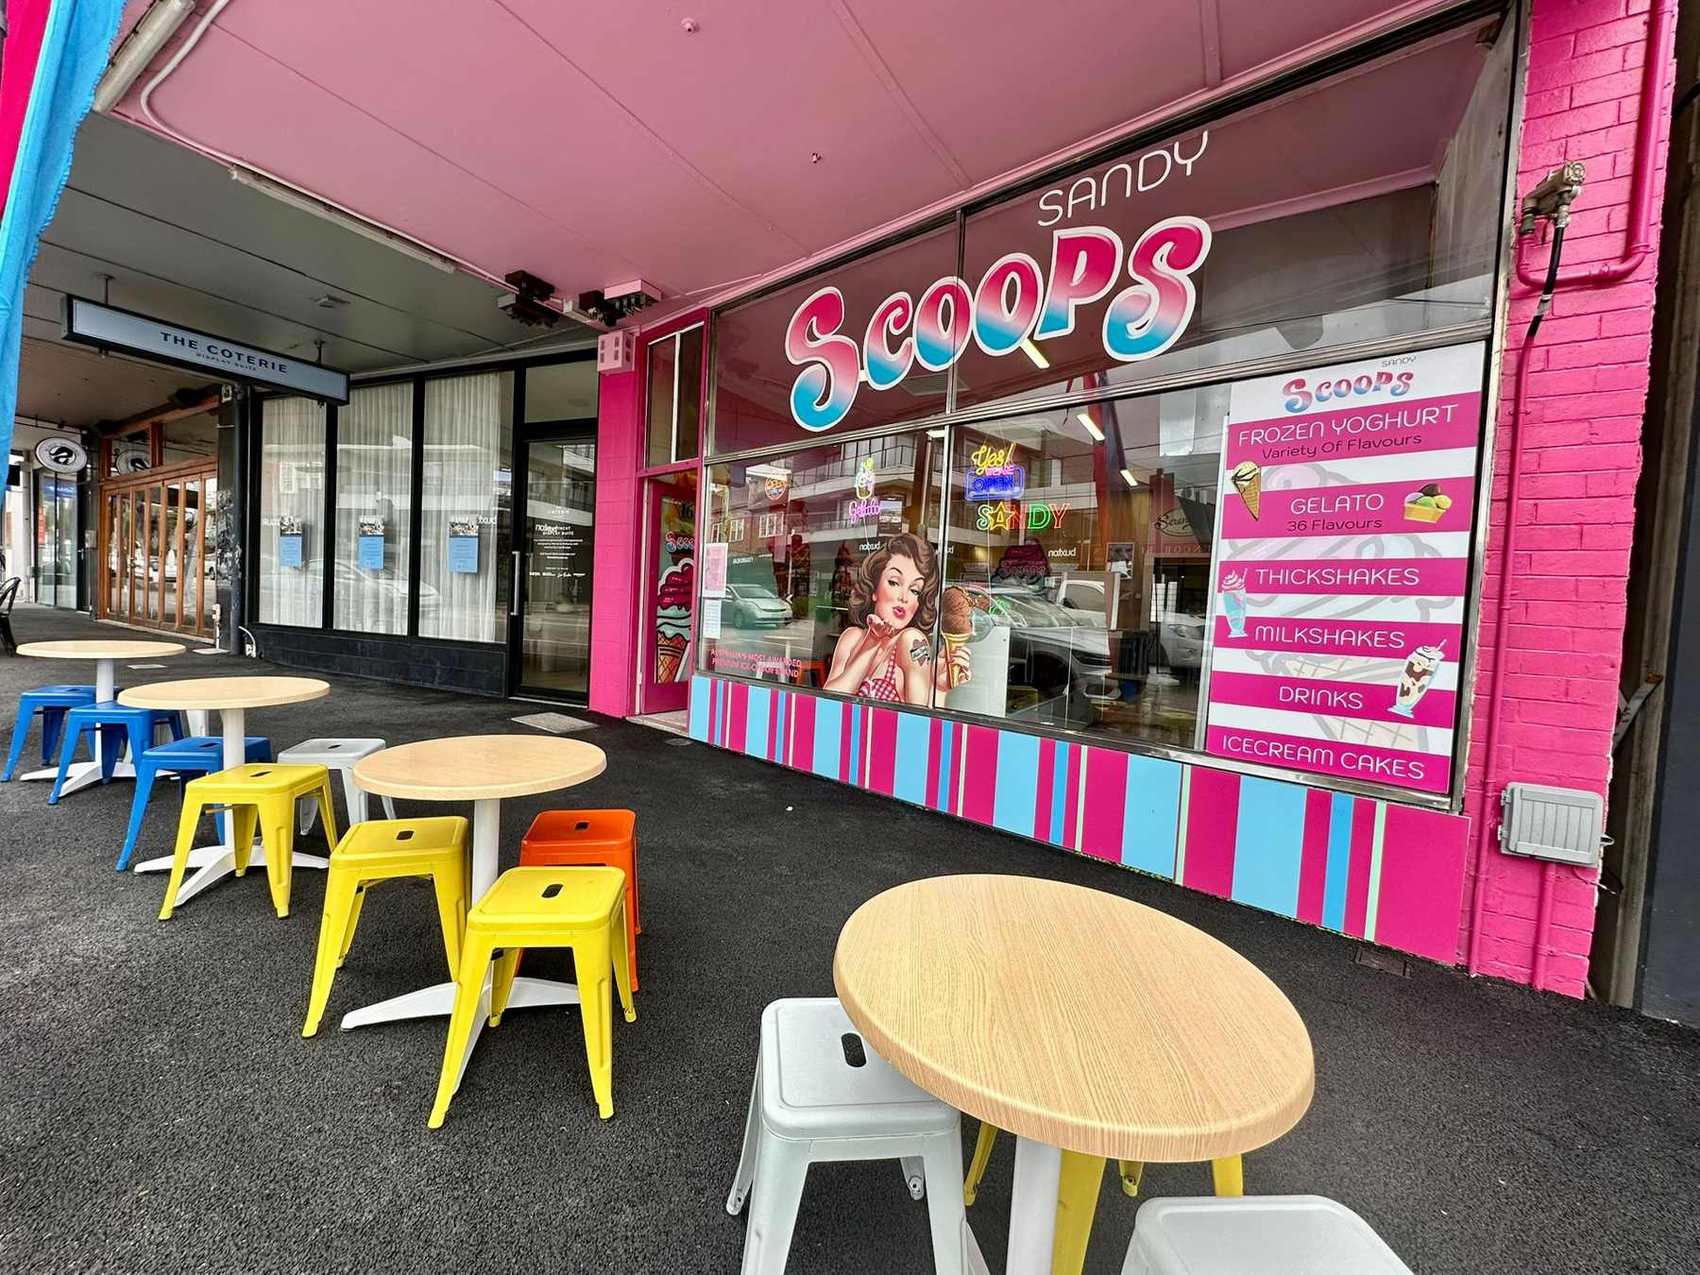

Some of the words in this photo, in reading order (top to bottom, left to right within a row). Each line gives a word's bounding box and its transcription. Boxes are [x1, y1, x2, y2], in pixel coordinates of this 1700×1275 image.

[1037, 129, 1209, 226] SANDY
[785, 216, 1213, 432] SCOOPS
[160, 331, 198, 350] THE
[206, 344, 288, 373] COTERIE
[1381, 356, 1416, 367] SANDY
[1282, 371, 1414, 413] SCOOPS
[1239, 421, 1325, 447] FROZEN
[1331, 404, 1459, 434] YOGHURT
[971, 441, 1017, 475] Yes!
[1262, 444, 1317, 459] Variety
[1321, 440, 1343, 453] Of
[1347, 434, 1422, 451] Flavours
[976, 501, 1072, 531] SANDY
[1290, 493, 1384, 515] GELATO
[1287, 519, 1307, 531] 36
[1312, 518, 1382, 531] Flavours
[1256, 568, 1420, 586] THICKSHAKES
[1255, 625, 1405, 649] MILKSHAKES
[1279, 686, 1363, 709] DRINKS
[1223, 735, 1333, 766] ICECREAM
[1340, 752, 1425, 780] CAKES
